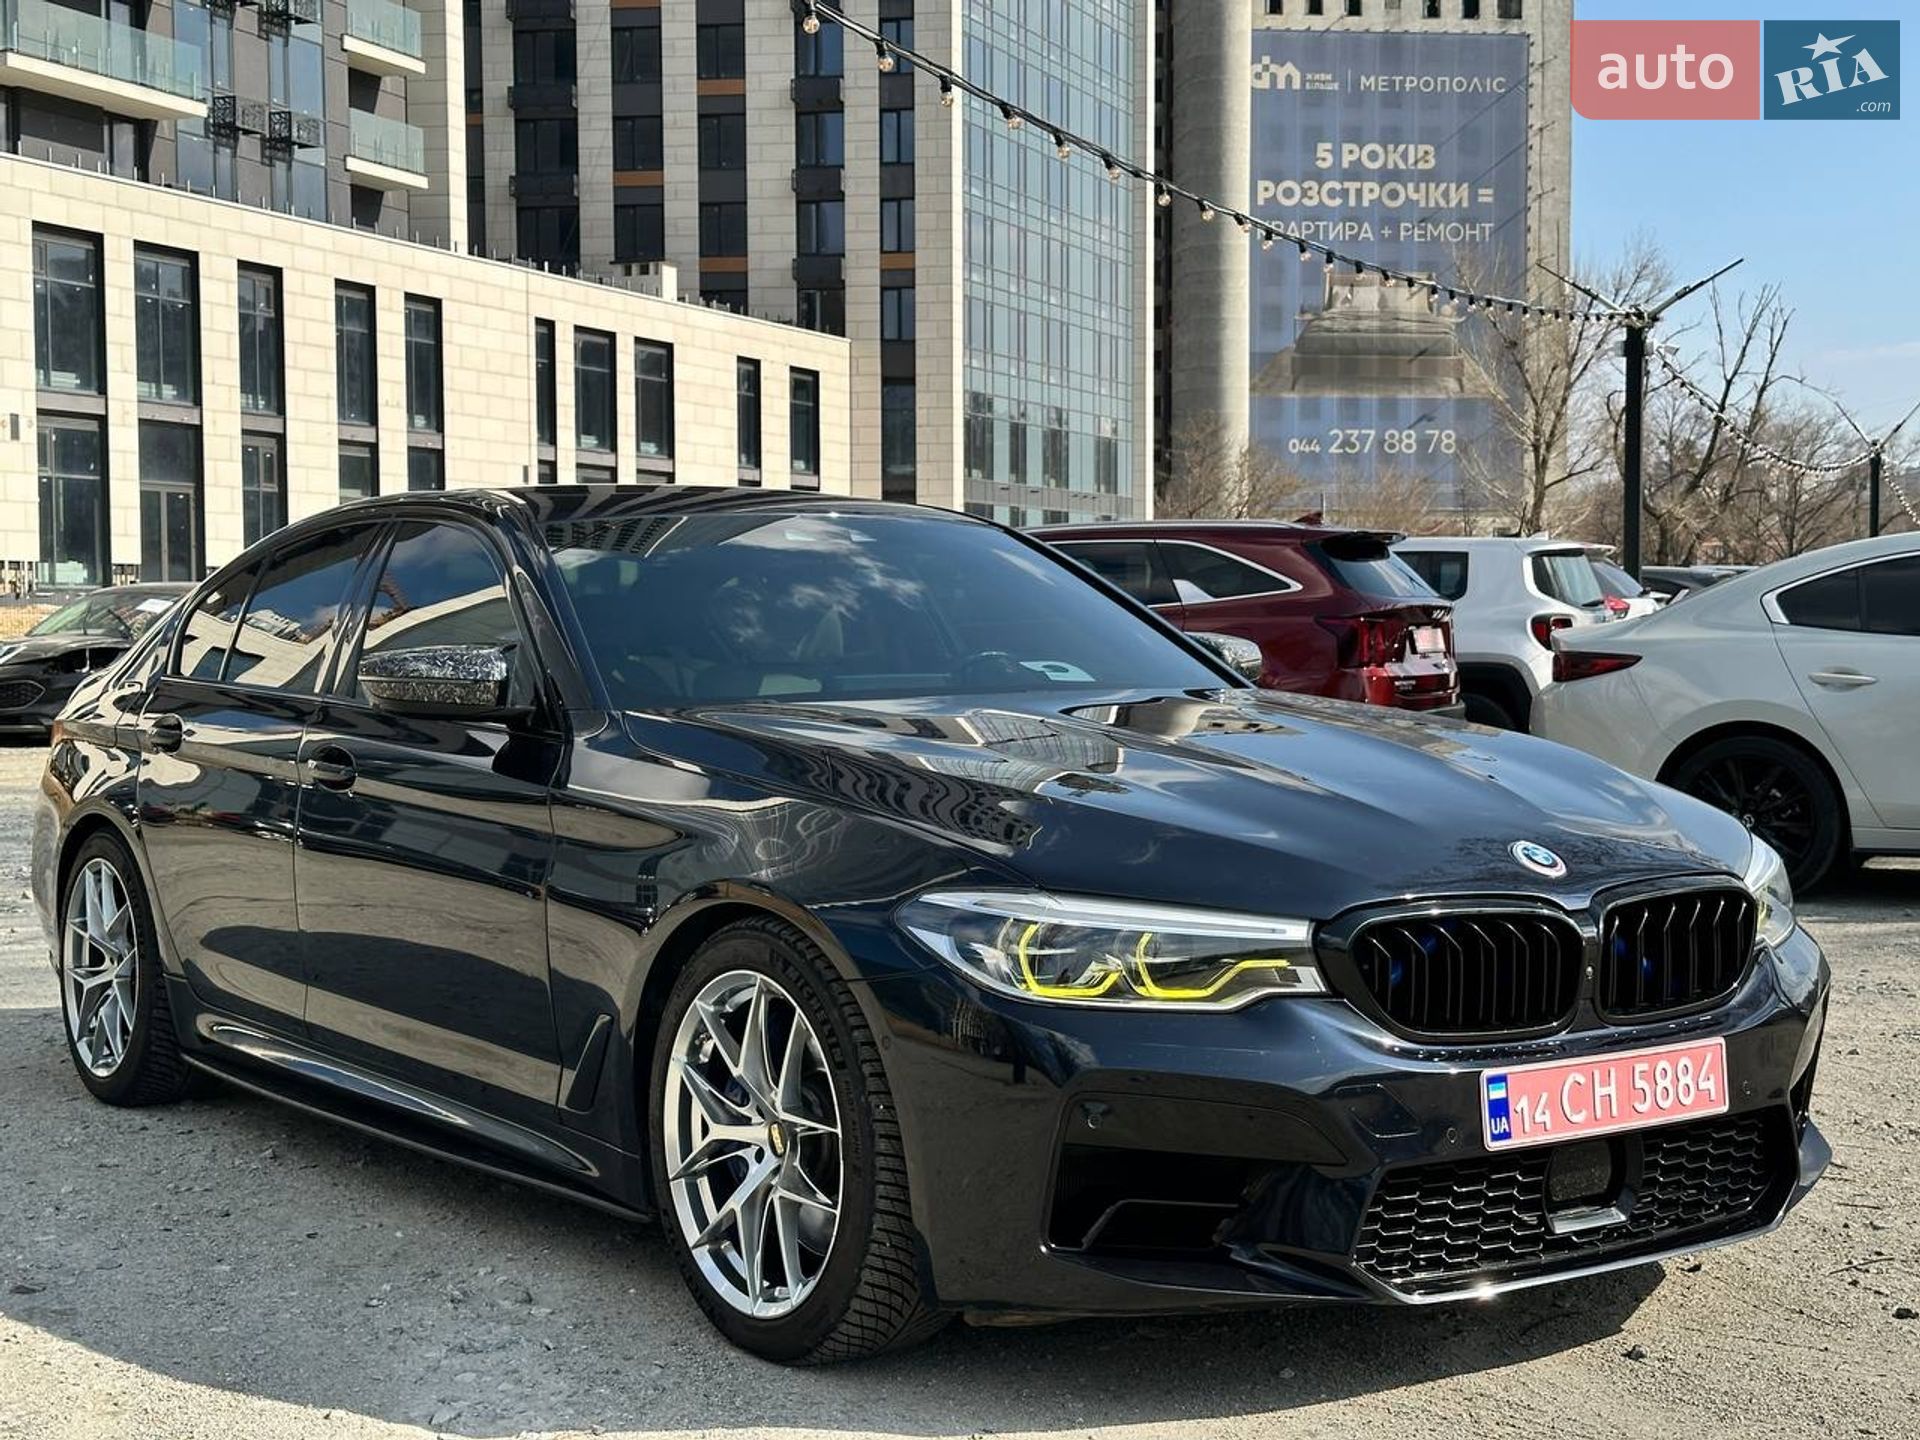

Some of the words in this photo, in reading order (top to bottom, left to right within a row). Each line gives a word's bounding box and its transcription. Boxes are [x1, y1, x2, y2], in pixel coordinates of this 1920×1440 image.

[1360, 75, 1506, 92] МЕТРОПОЛІС
[1315, 142, 1334, 169] 5
[1341, 143, 1435, 169] РОКІВ
[1257, 180, 1469, 208] РОЗСТРОЧКИ
[1381, 227, 1392, 238] +
[1400, 223, 1494, 242] РЕМОНТ
[1289, 438, 1321, 453] 044
[1328, 429, 1376, 453] 237
[1384, 429, 1417, 453] 88
[1425, 429, 1456, 453] 78
[1491, 1118, 1510, 1135] UA
[1514, 1092, 1551, 1134] 14
[1632, 1052, 1716, 1113] 5884
